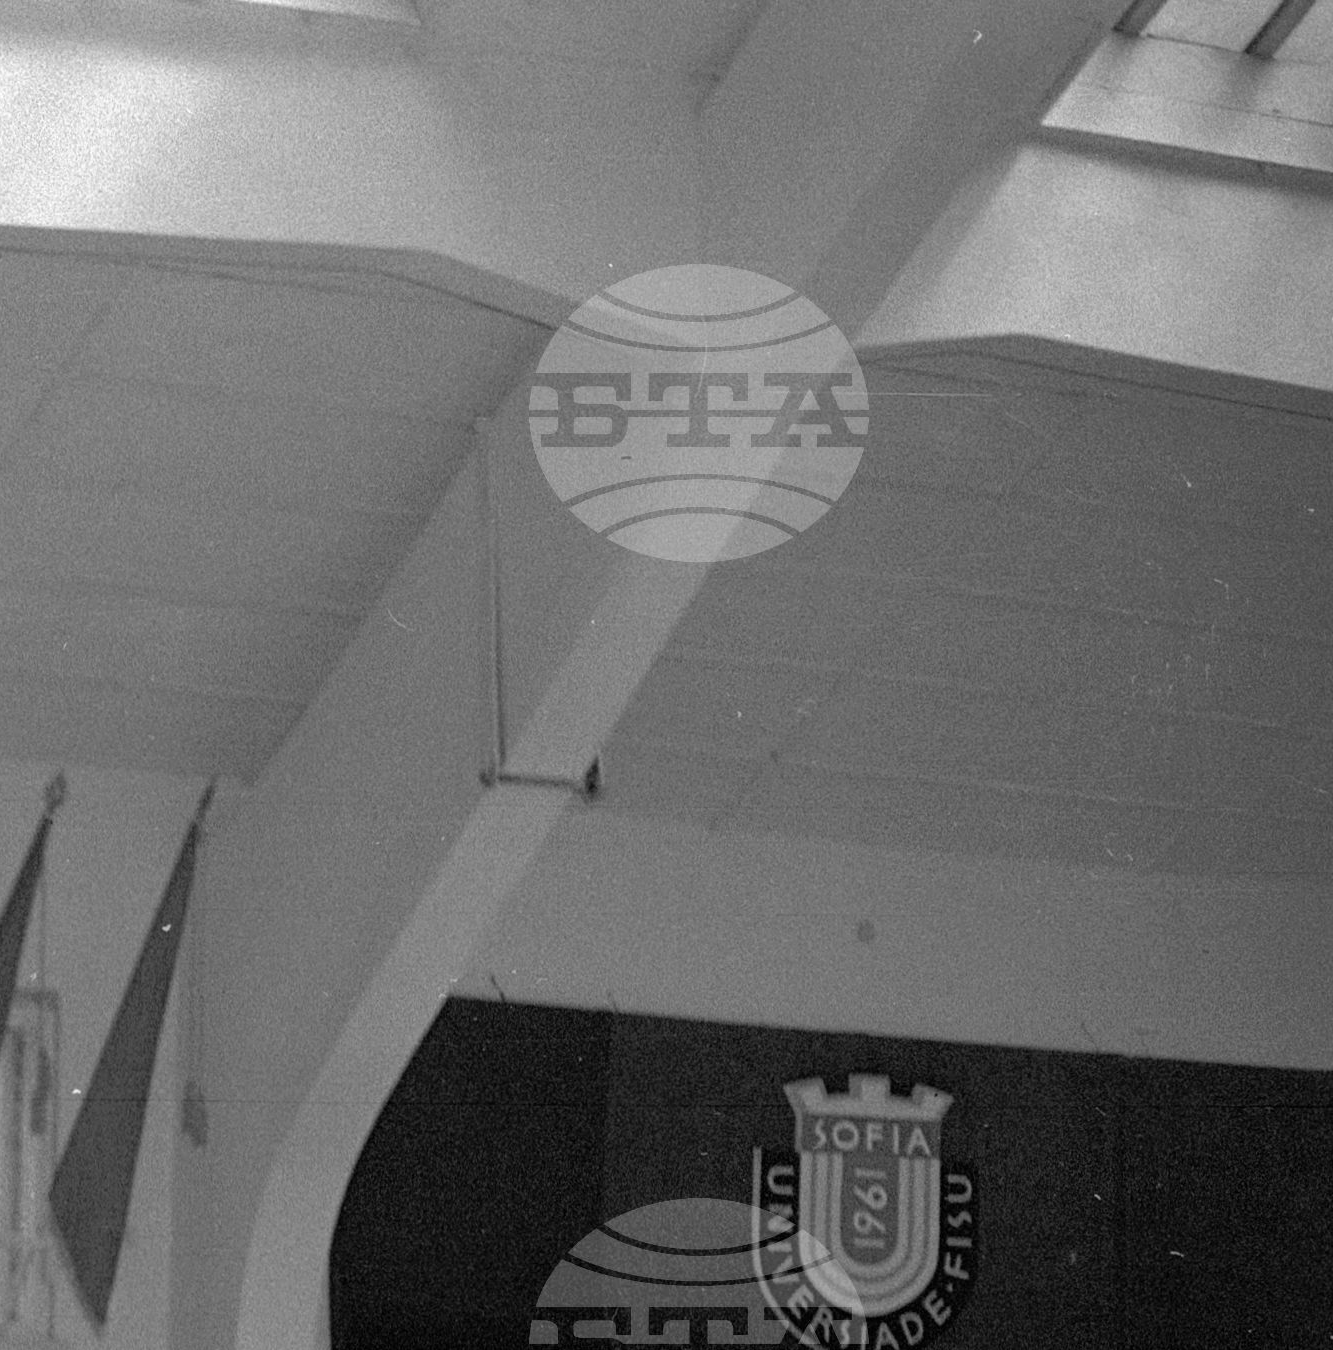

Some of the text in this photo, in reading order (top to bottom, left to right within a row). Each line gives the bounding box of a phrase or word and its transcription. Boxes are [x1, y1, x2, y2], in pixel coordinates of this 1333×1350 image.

[813, 1119, 932, 1155] SOFIA
[853, 1166, 888, 1250] 1961
[943, 1173, 974, 1281] FISU
